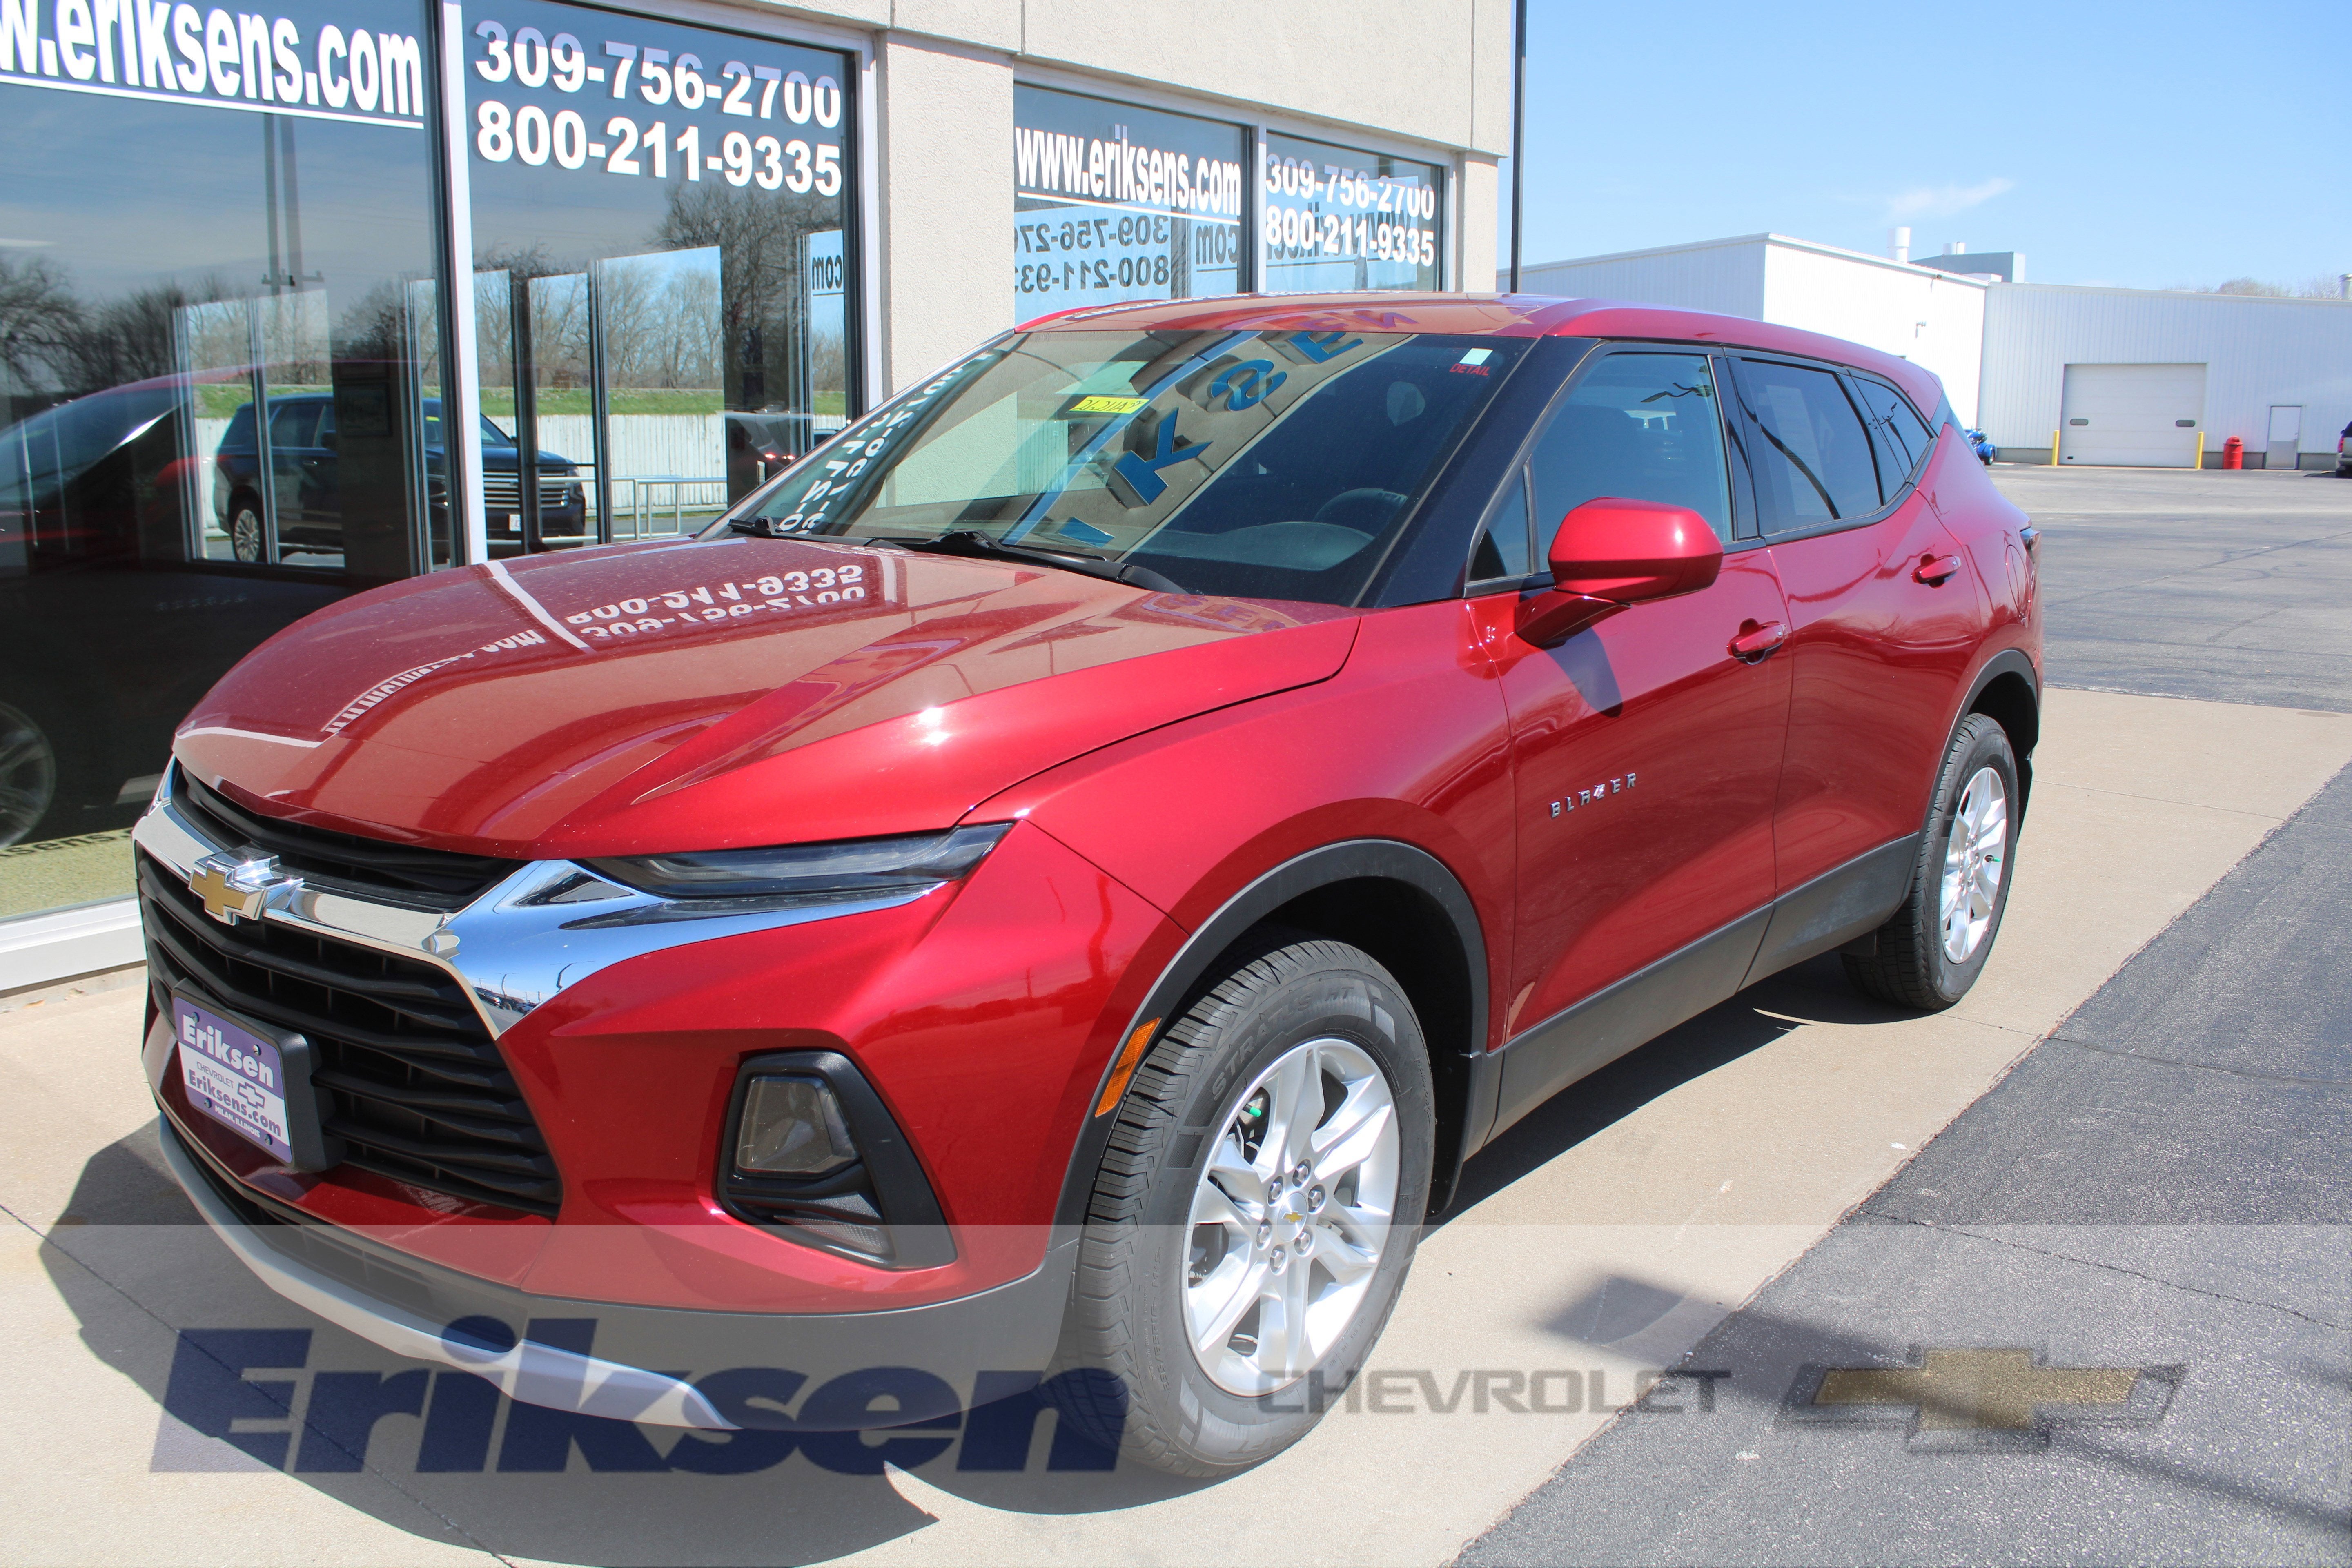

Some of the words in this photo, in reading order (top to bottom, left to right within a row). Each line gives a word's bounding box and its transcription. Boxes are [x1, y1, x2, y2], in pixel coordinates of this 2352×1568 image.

[475, 20, 840, 129] 309-756-2700
[477, 101, 842, 197] 800-211-9335
[1015, 124, 1241, 216] www.eriksens.com
[1266, 154, 1434, 220] 309-756-2700
[1266, 205, 1434, 267] 800-211-9335
[1449, 363, 1490, 376] DETAIL
[1549, 773, 1636, 818] BLAZER
[183, 1014, 274, 1089] Eriksen
[197, 1061, 234, 1089] CHEVROLET
[189, 1069, 282, 1137] Eriksens.com
[235, 1117, 261, 1138] ILLINOIS
